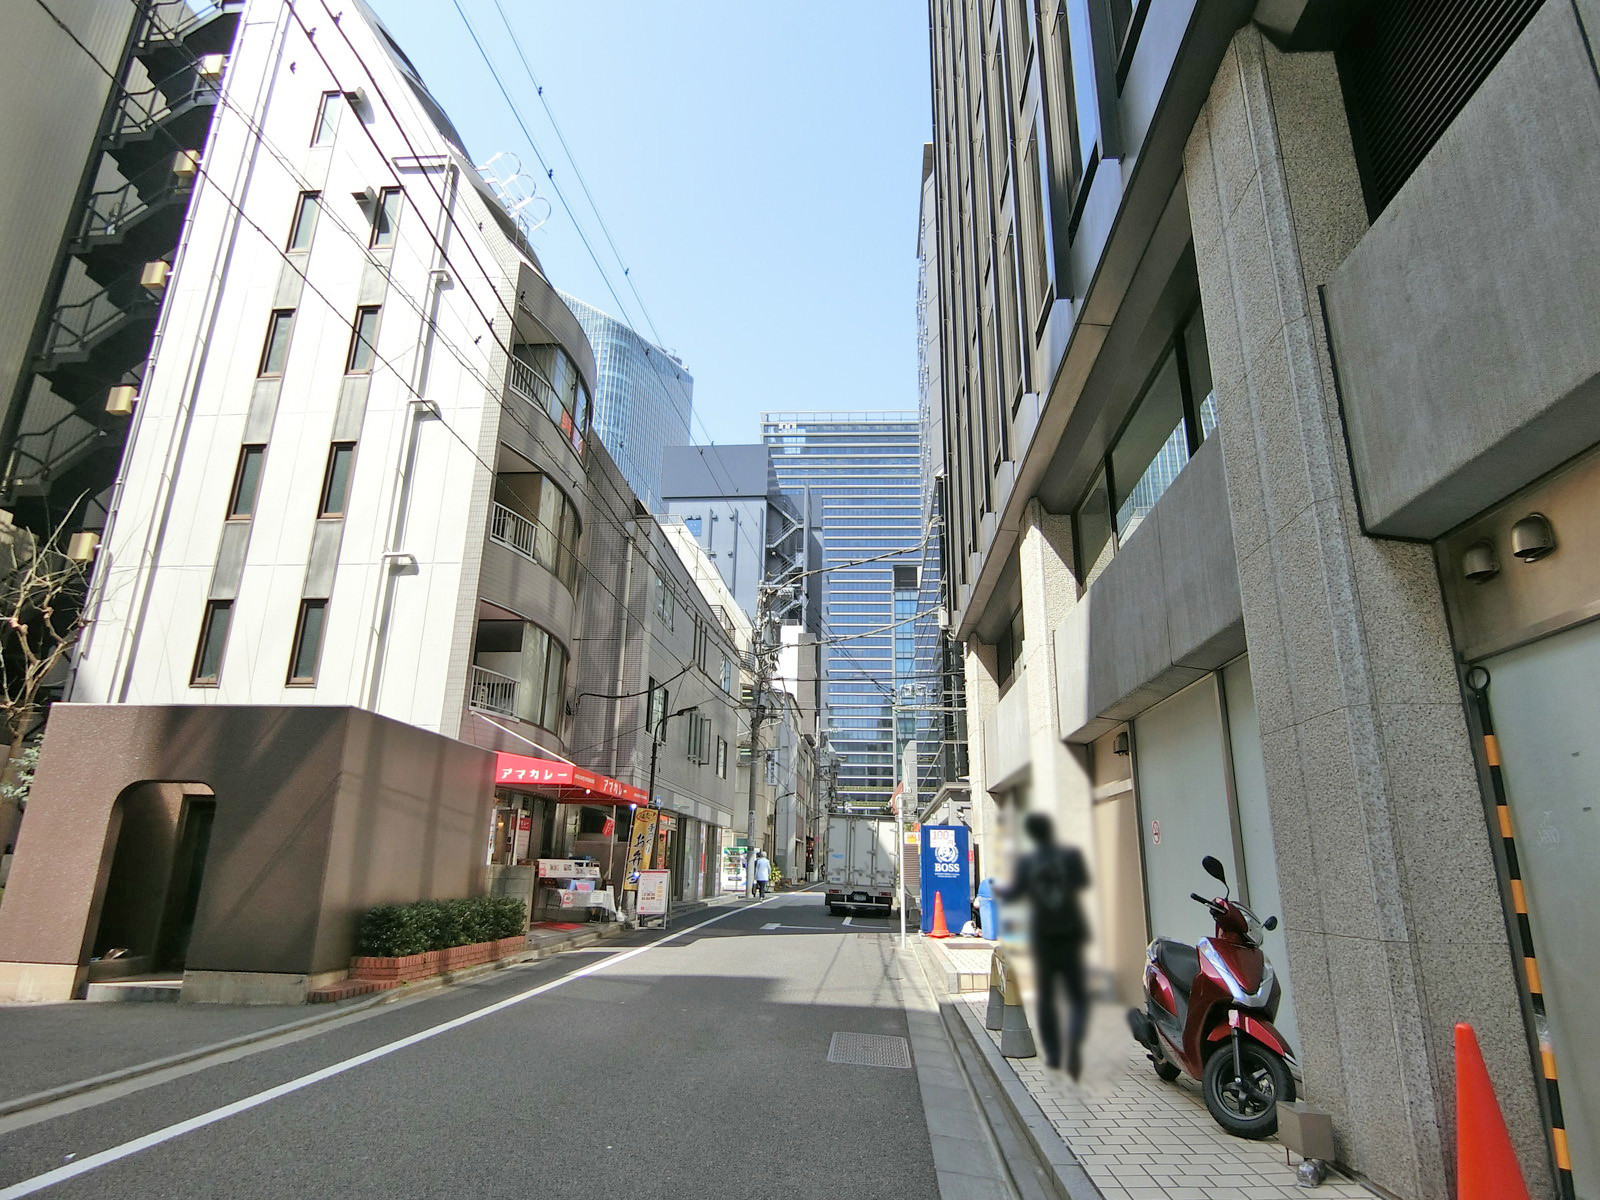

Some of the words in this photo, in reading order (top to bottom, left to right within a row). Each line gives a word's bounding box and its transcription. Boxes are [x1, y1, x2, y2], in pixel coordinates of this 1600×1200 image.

[501, 768, 568, 780] アマカレー
[603, 779, 627, 796] アマカレー
[935, 863, 960, 873] BOSS
